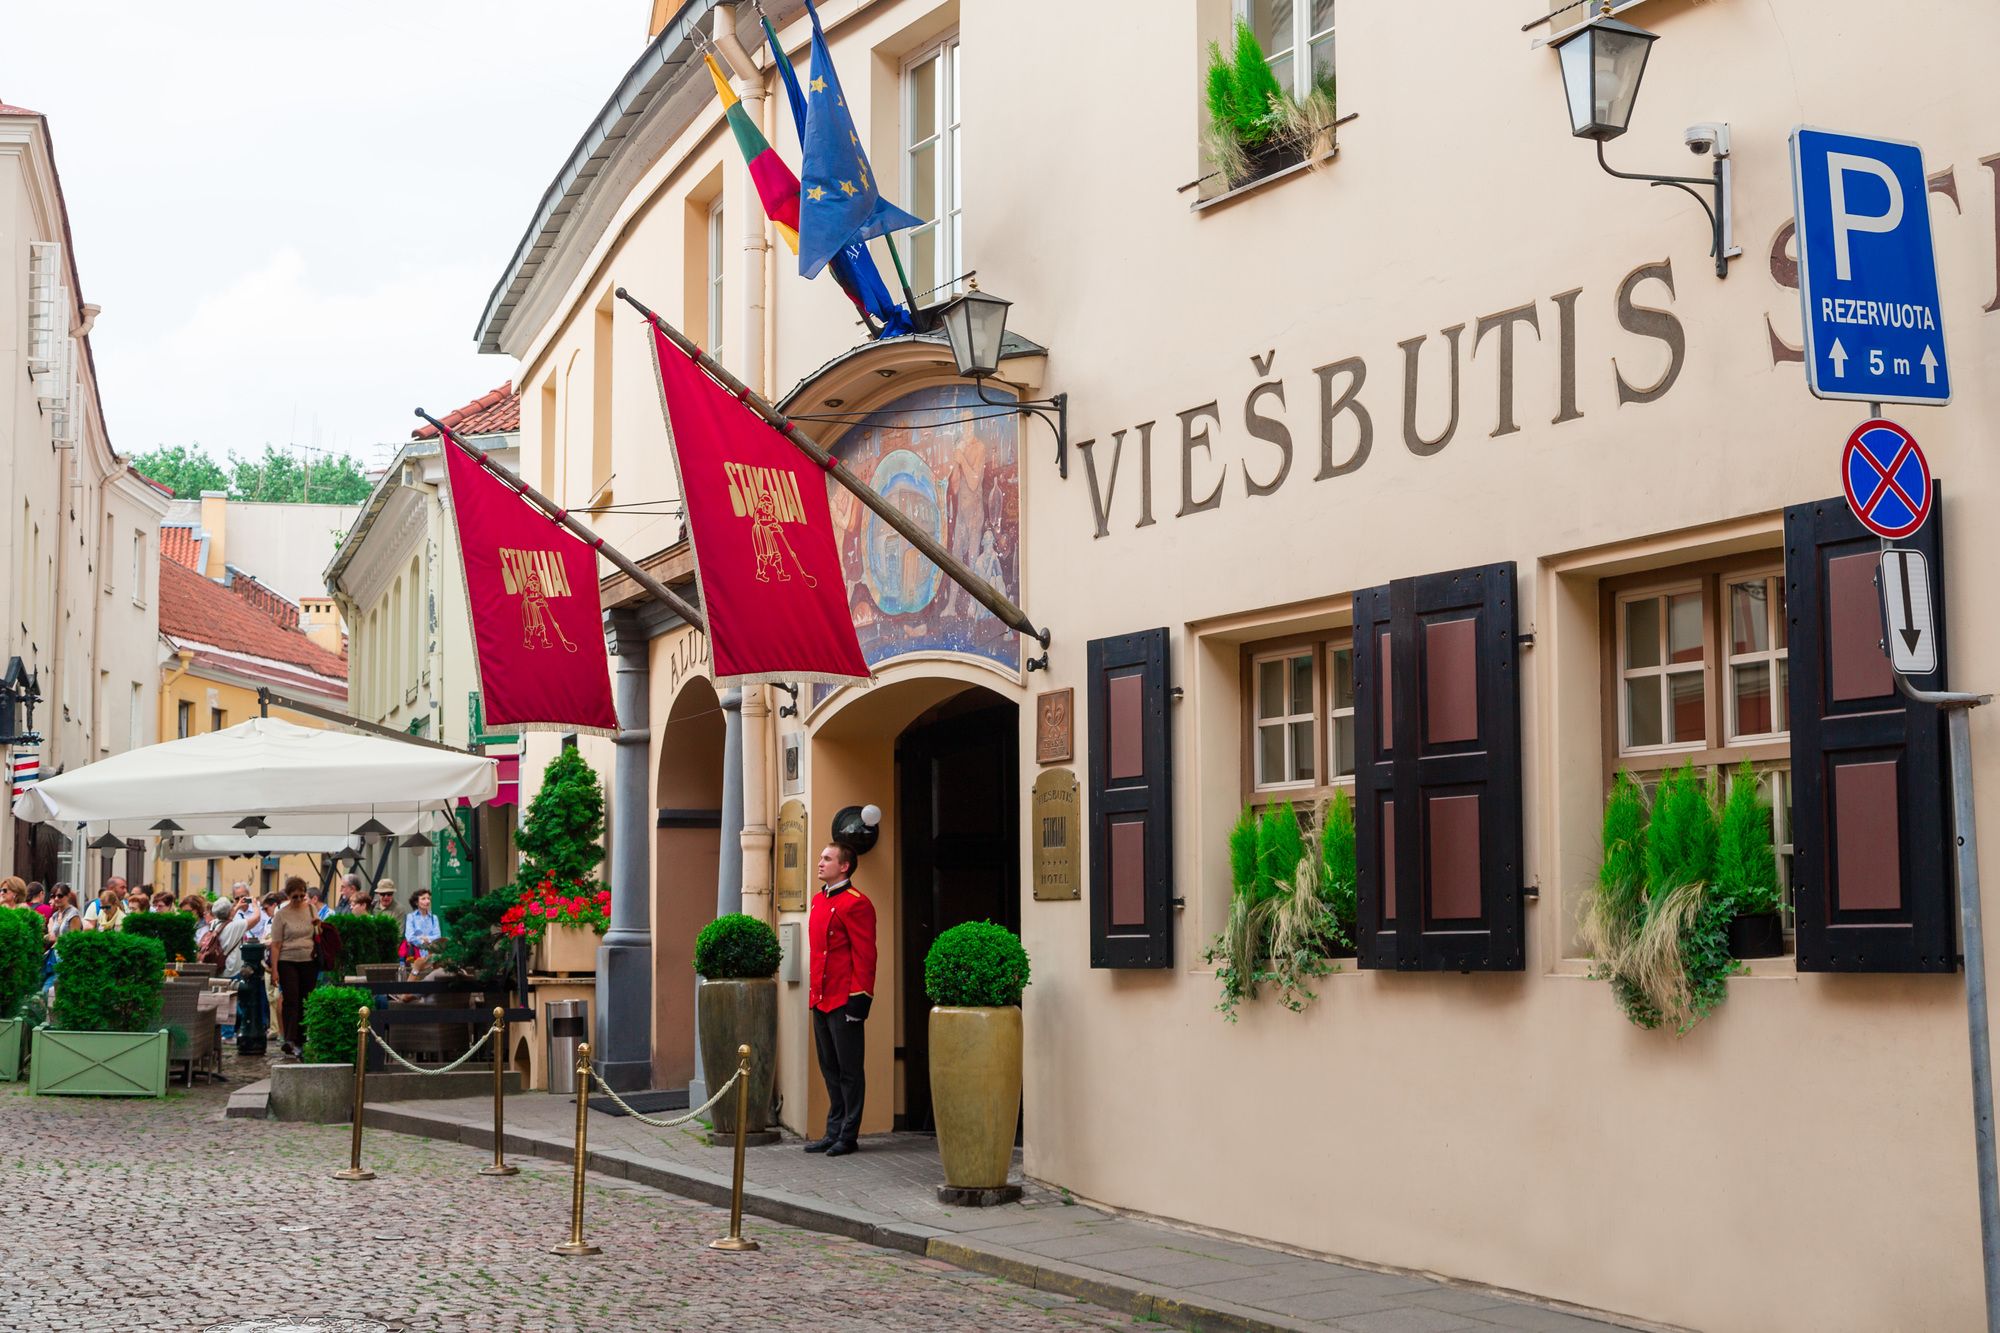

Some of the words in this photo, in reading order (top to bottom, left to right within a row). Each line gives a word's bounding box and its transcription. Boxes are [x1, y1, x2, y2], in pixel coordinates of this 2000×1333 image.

[1826, 151, 1905, 281] P
[1821, 297, 1936, 331] REZERVUOTA
[1869, 349, 1885, 376] 5
[1893, 357, 1911, 376] m
[1075, 256, 1686, 540] VIEŠBUTIS
[1041, 872, 1069, 885] HOTEL
